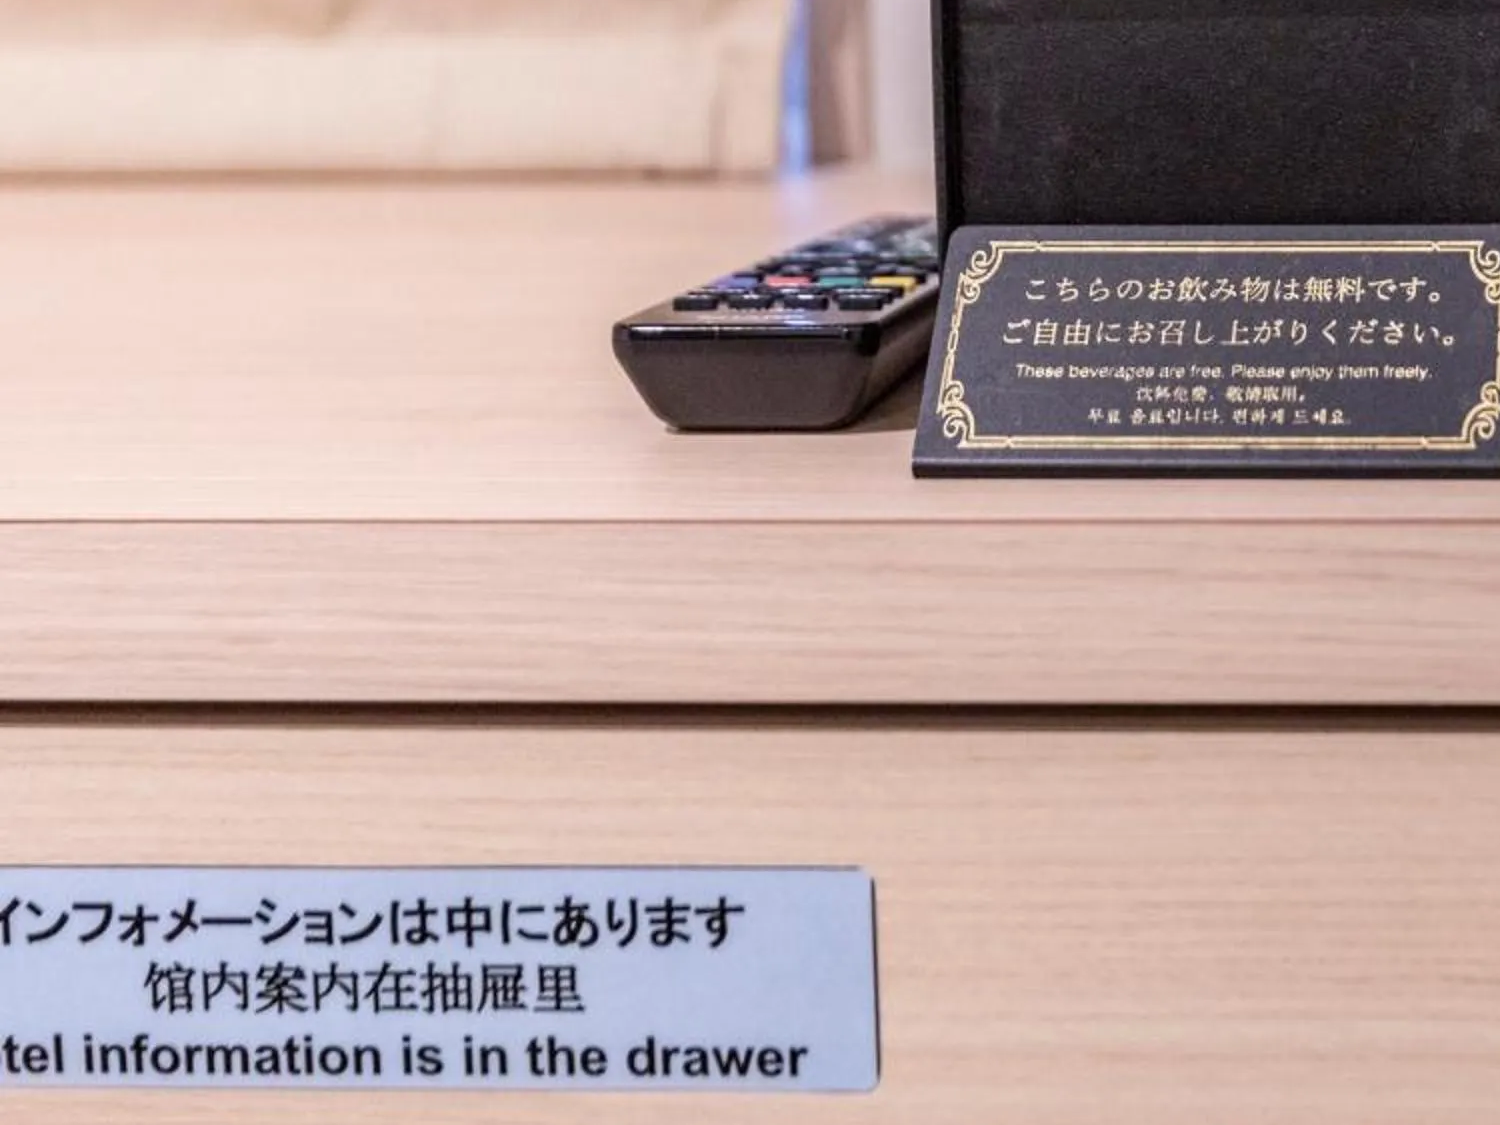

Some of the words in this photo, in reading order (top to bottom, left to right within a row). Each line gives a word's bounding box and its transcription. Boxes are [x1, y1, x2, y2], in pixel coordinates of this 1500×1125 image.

[1025, 275, 1441, 304] こちらのお飲み物は無料です。
[1002, 317, 1456, 347] ご自由にお召し上がりください。
[1016, 363, 1064, 379] These
[1068, 364, 1155, 382] beverages
[1159, 366, 1186, 379] are
[1190, 364, 1225, 379] free.
[1231, 364, 1285, 379] Please
[1290, 364, 1334, 382] enjoy
[1339, 364, 1380, 379] them
[1384, 364, 1433, 382] freely.
[144, 961, 585, 1014] 馆内案内在抽屉里
[0, 1033, 65, 1074] tel
[83, 1033, 382, 1076] information
[401, 1034, 444, 1076] is
[463, 1035, 508, 1077] in
[526, 1035, 608, 1077] the
[626, 1036, 809, 1078] drawer
